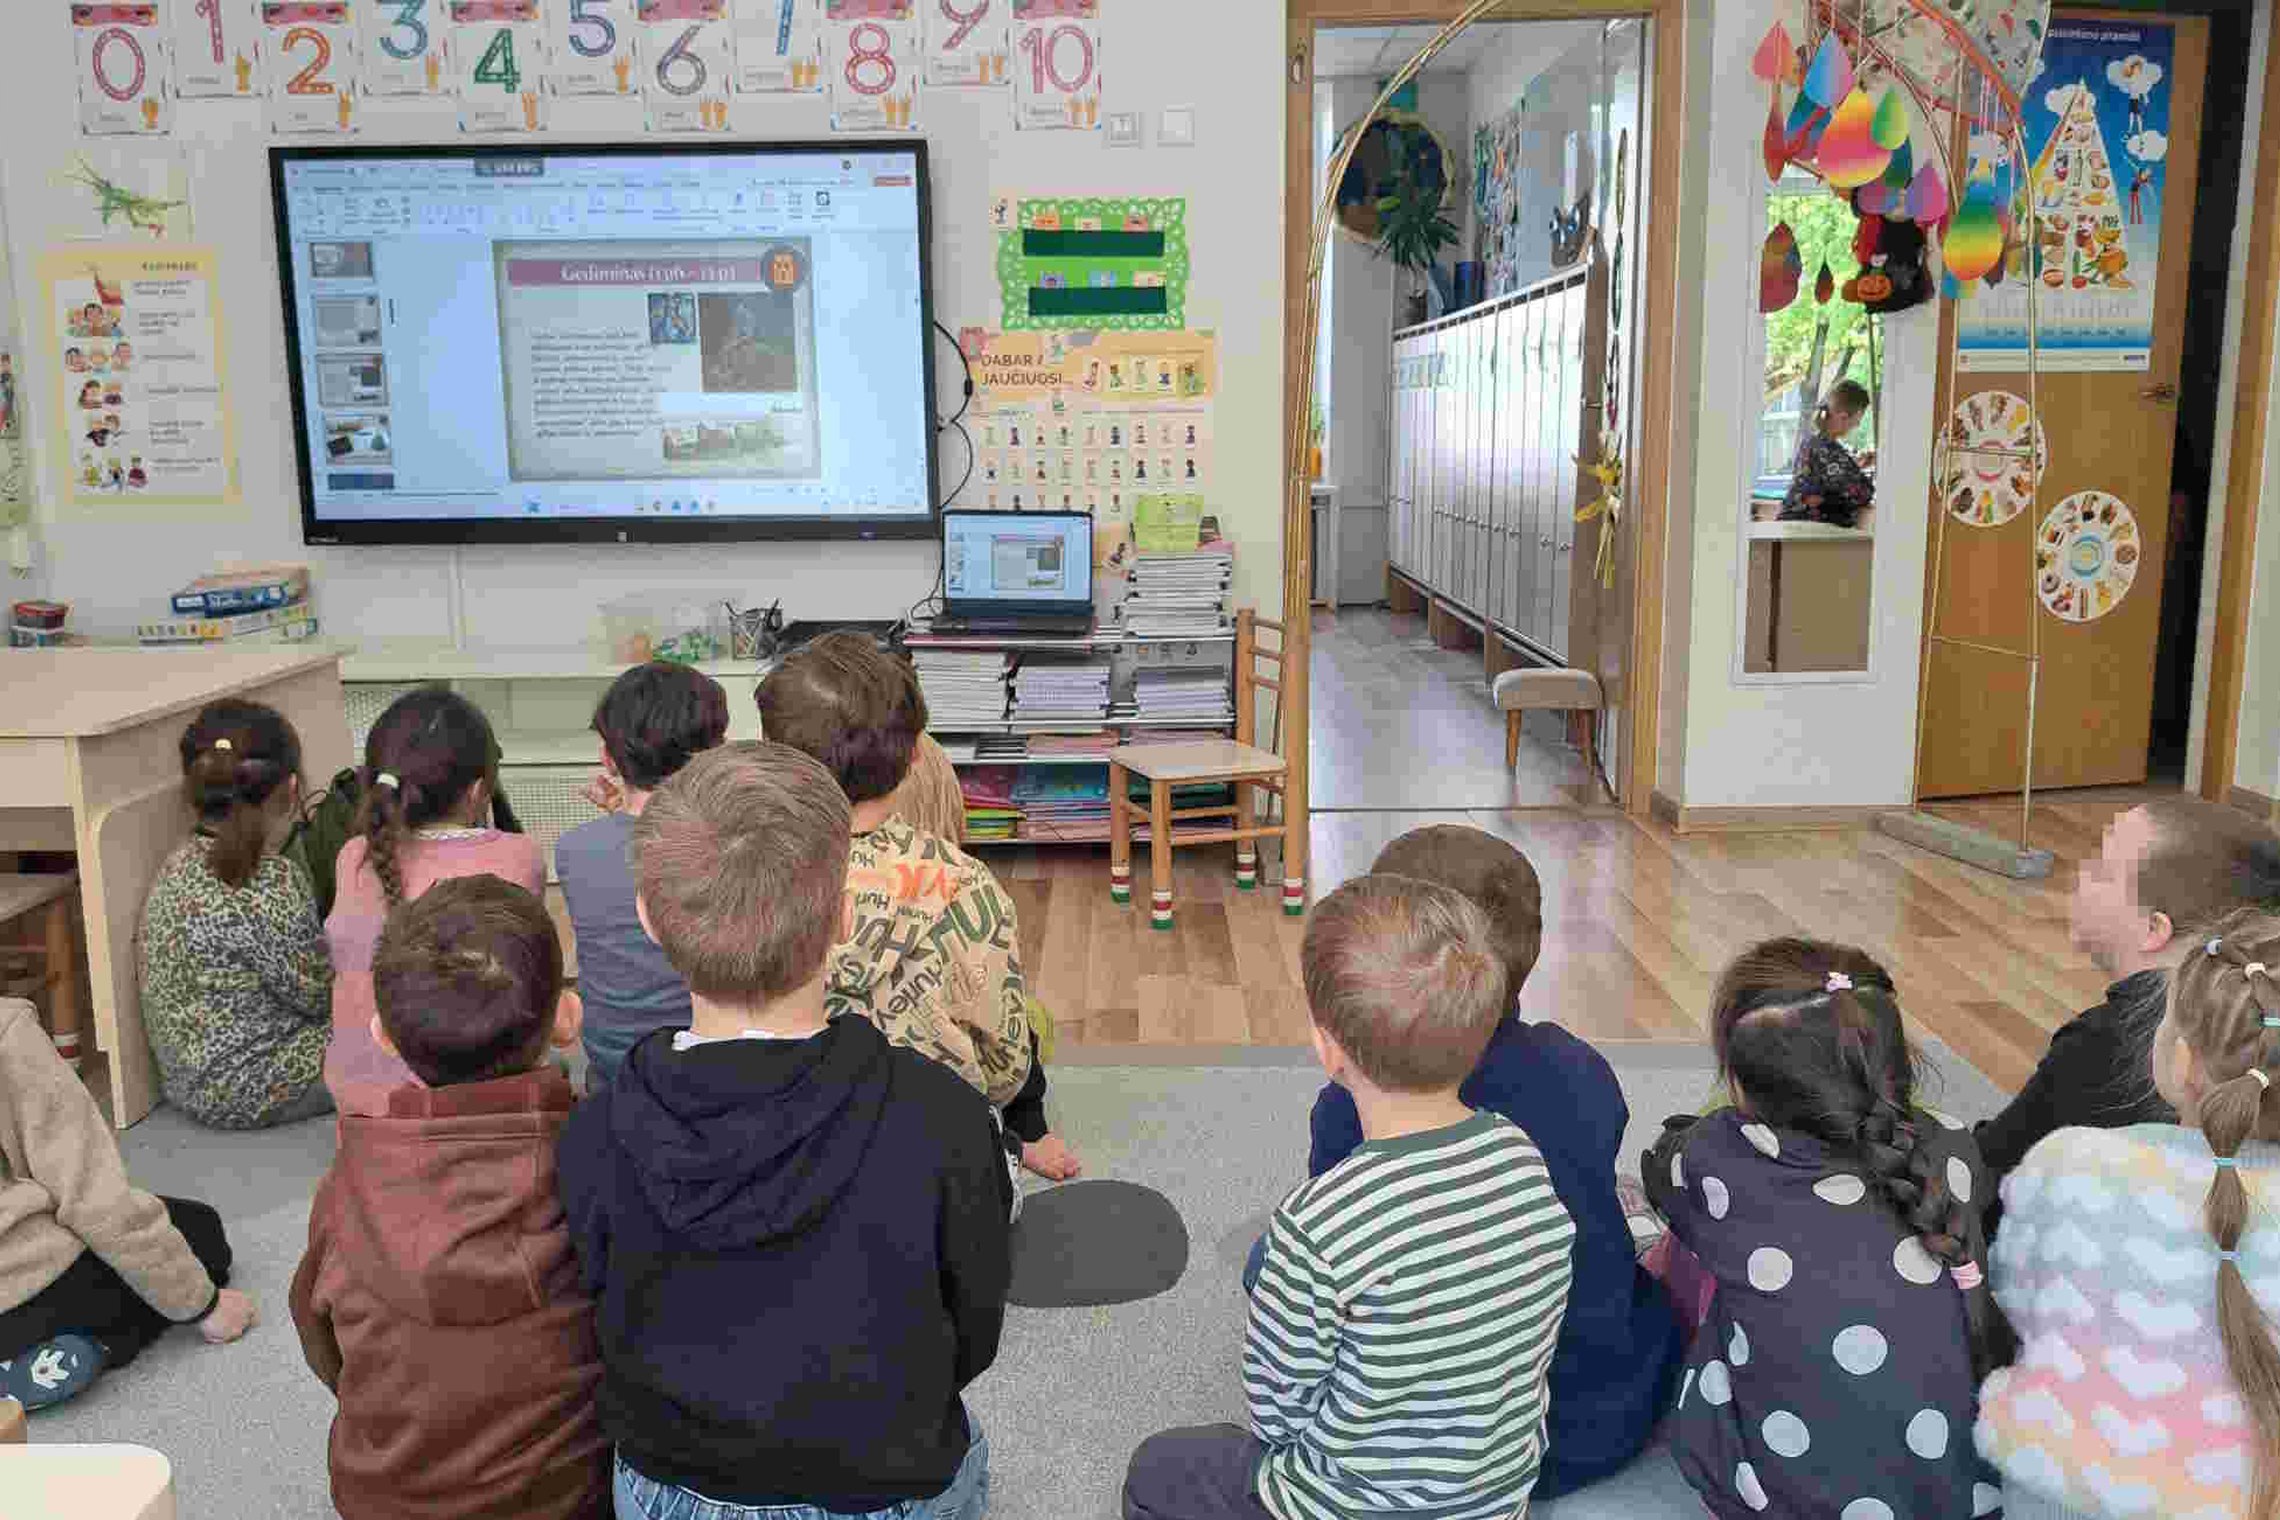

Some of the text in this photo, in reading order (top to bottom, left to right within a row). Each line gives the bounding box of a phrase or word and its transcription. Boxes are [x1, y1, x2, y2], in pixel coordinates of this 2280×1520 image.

[195, 0, 224, 65] 1
[379, 0, 428, 59] 3
[568, 0, 616, 57] 5
[939, 0, 990, 51] 9
[92, 27, 145, 101] 0
[283, 27, 336, 94] 2
[473, 28, 521, 94] 4
[656, 24, 706, 96] 6
[844, 23, 896, 95] 8
[1018, 24, 1093, 94] 10
